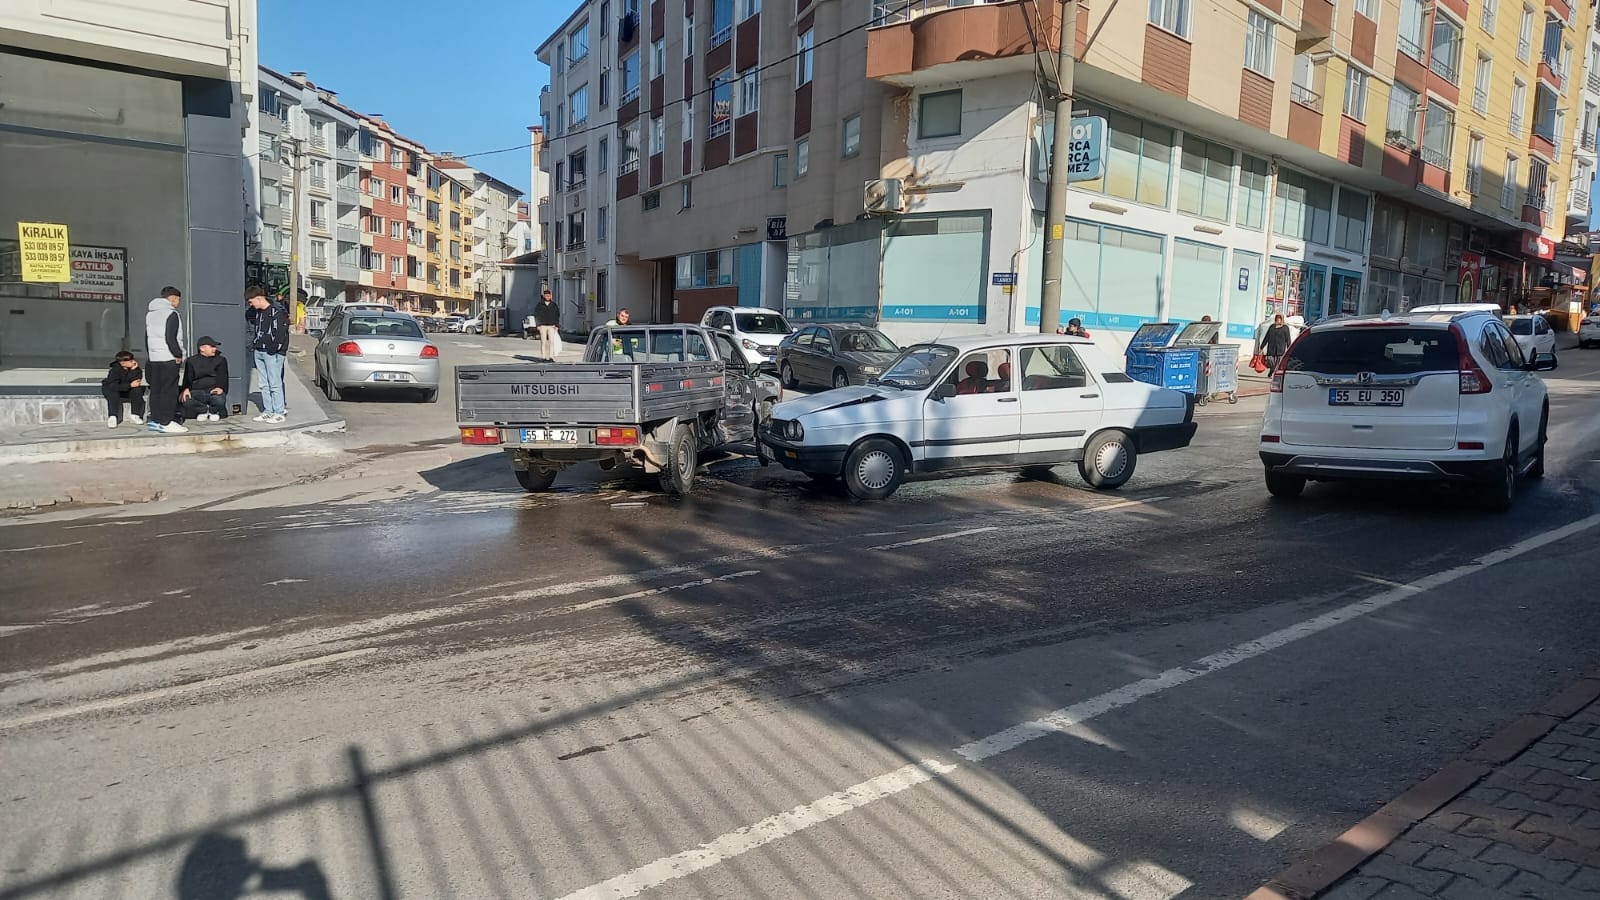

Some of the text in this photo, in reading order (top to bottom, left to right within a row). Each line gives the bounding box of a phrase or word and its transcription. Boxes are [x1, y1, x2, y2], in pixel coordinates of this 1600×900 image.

[57, 242, 65, 252] 57
[58, 253, 66, 262] 57
[70, 249, 94, 259] KAYA
[73, 261, 111, 271] SATILIK
[511, 384, 580, 396] MITSUBISHI
[1336, 390, 1401, 402] 55 EU 350
[526, 430, 537, 441] 55
[560, 430, 576, 441] 272
